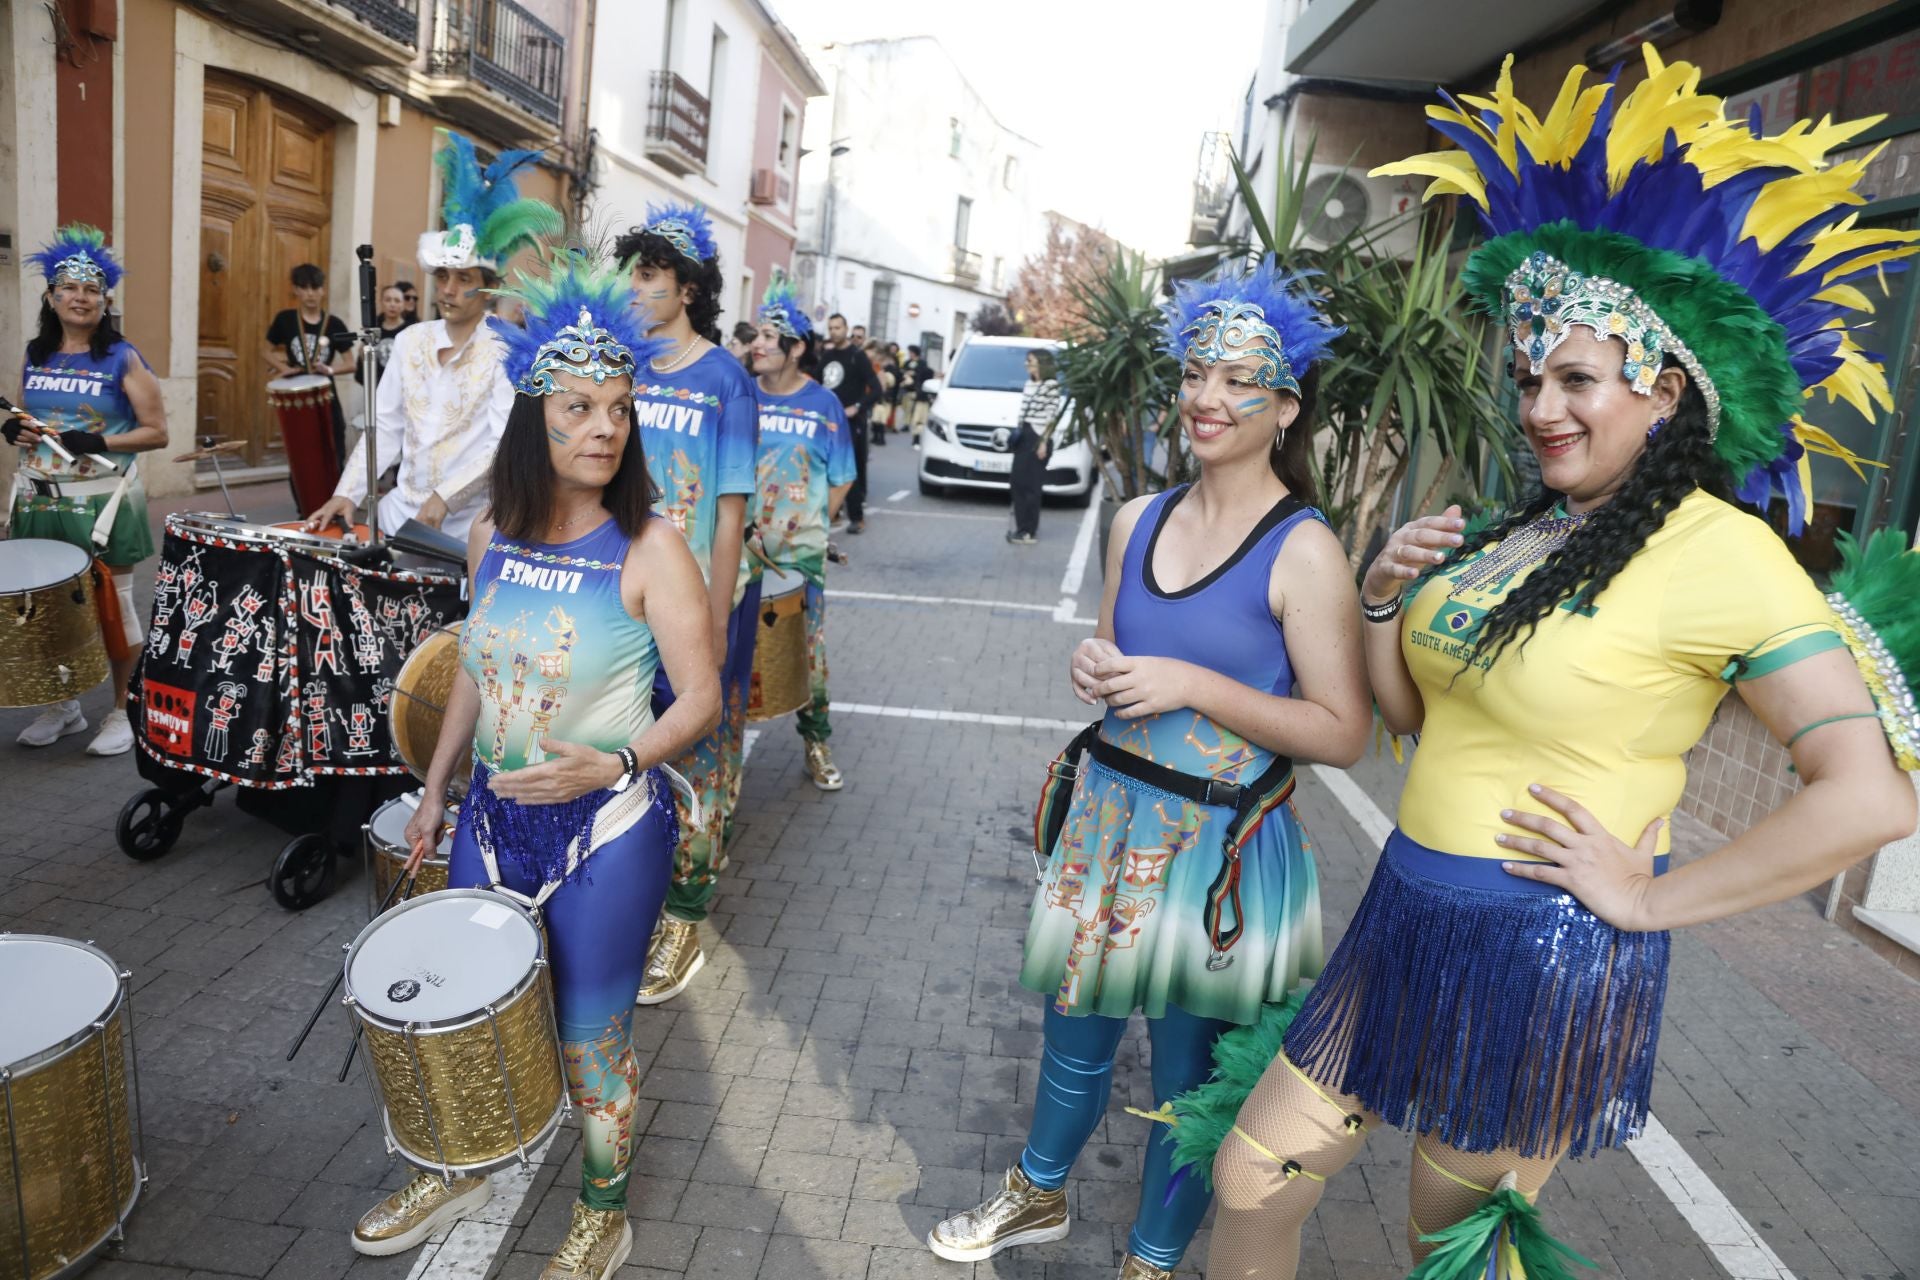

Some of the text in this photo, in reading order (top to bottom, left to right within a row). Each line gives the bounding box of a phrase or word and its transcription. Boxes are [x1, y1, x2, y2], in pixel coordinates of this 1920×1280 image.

[25, 375, 103, 397] ESMUVI
[634, 400, 703, 437] MUVI
[759, 414, 817, 439] MUVI
[499, 558, 583, 593] ESMUVI
[1411, 630, 1441, 651] SOUTH
[147, 708, 189, 734] ESMUVI
